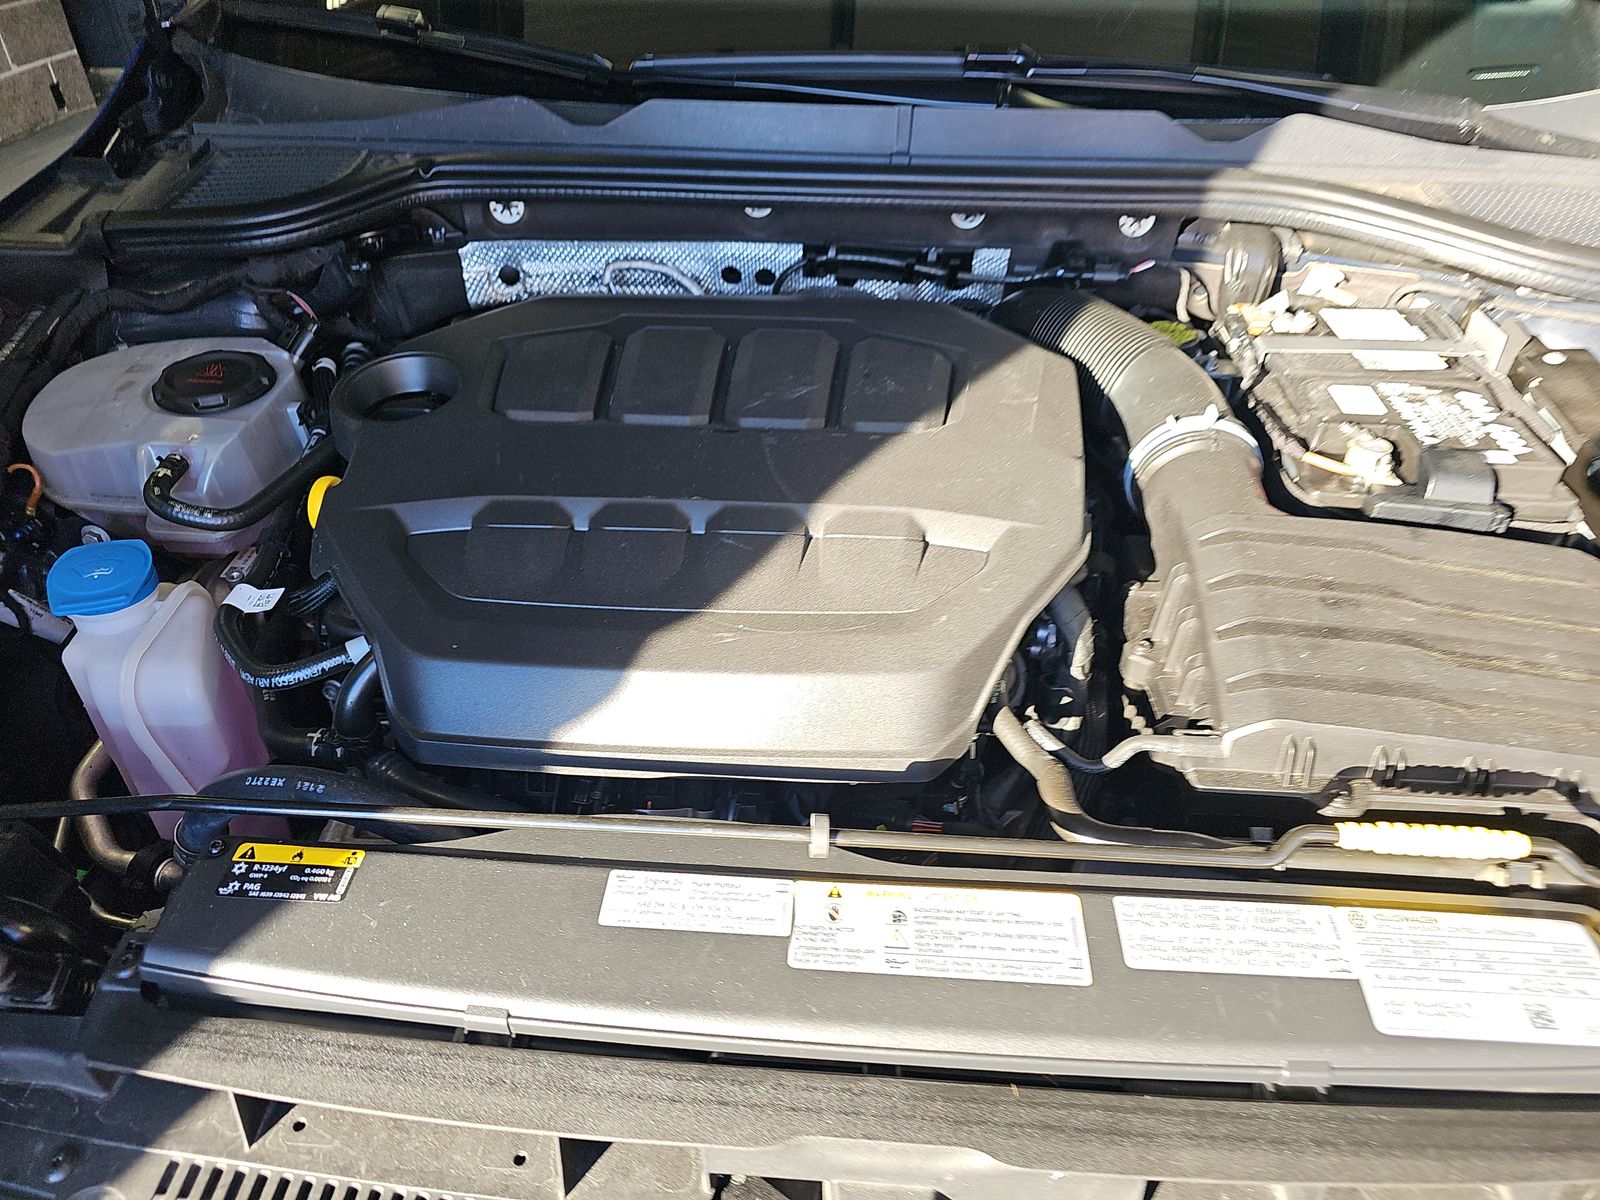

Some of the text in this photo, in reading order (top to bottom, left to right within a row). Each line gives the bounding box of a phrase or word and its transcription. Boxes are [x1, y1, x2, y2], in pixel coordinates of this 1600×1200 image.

[252, 863, 288, 874] R-1234yf
[304, 867, 326, 875] 0.460
[242, 882, 262, 891] PAG
